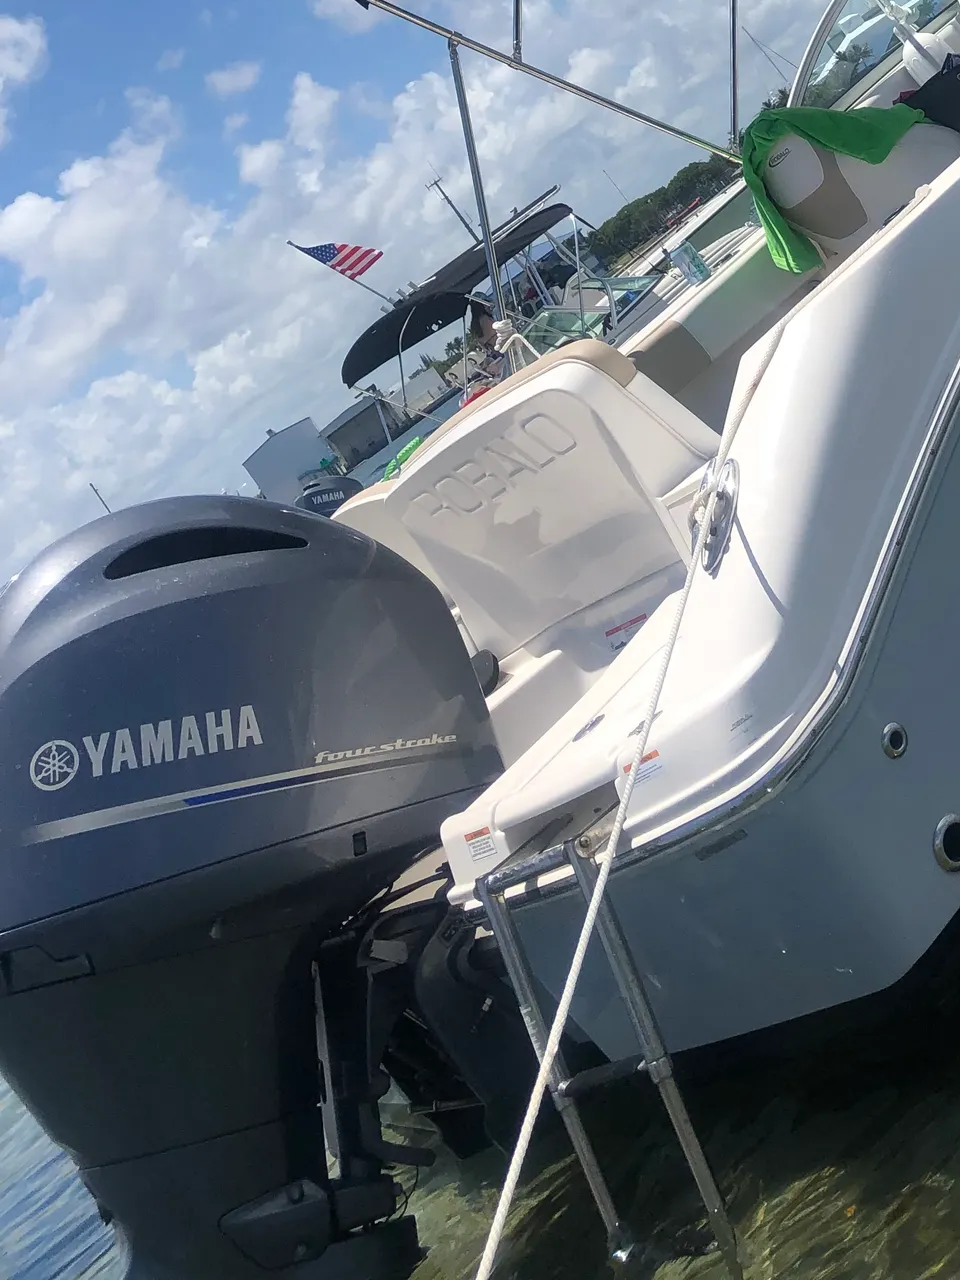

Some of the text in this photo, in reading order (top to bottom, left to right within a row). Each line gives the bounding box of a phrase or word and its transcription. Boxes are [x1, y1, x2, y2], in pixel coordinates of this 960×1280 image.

[311, 490, 345, 505] YAMAHA
[402, 412, 577, 520] ROBALO
[82, 704, 264, 778] YAMAHA
